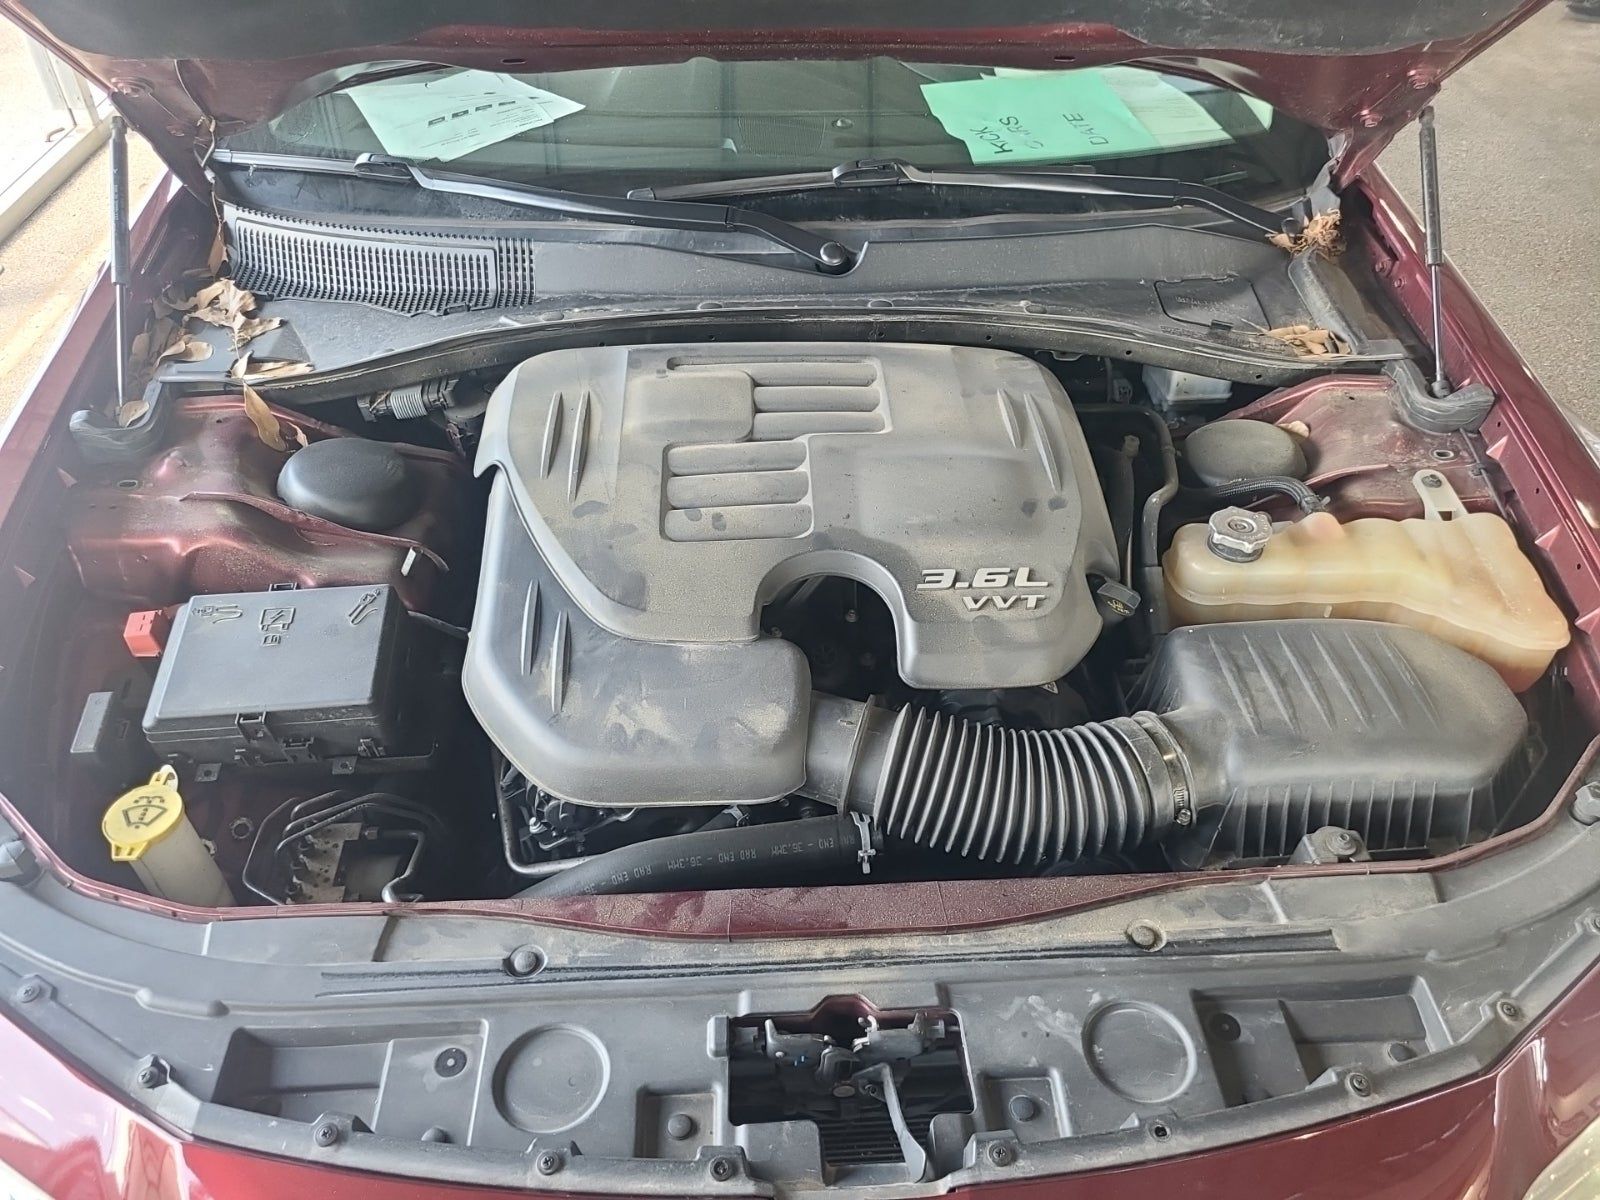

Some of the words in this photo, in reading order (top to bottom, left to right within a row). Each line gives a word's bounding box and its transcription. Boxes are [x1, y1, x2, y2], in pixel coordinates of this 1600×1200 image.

[1062, 112, 1109, 146] DATE
[917, 566, 1050, 591] 3.6L
[963, 594, 1047, 612] VVT
[633, 863, 653, 879] RAD
